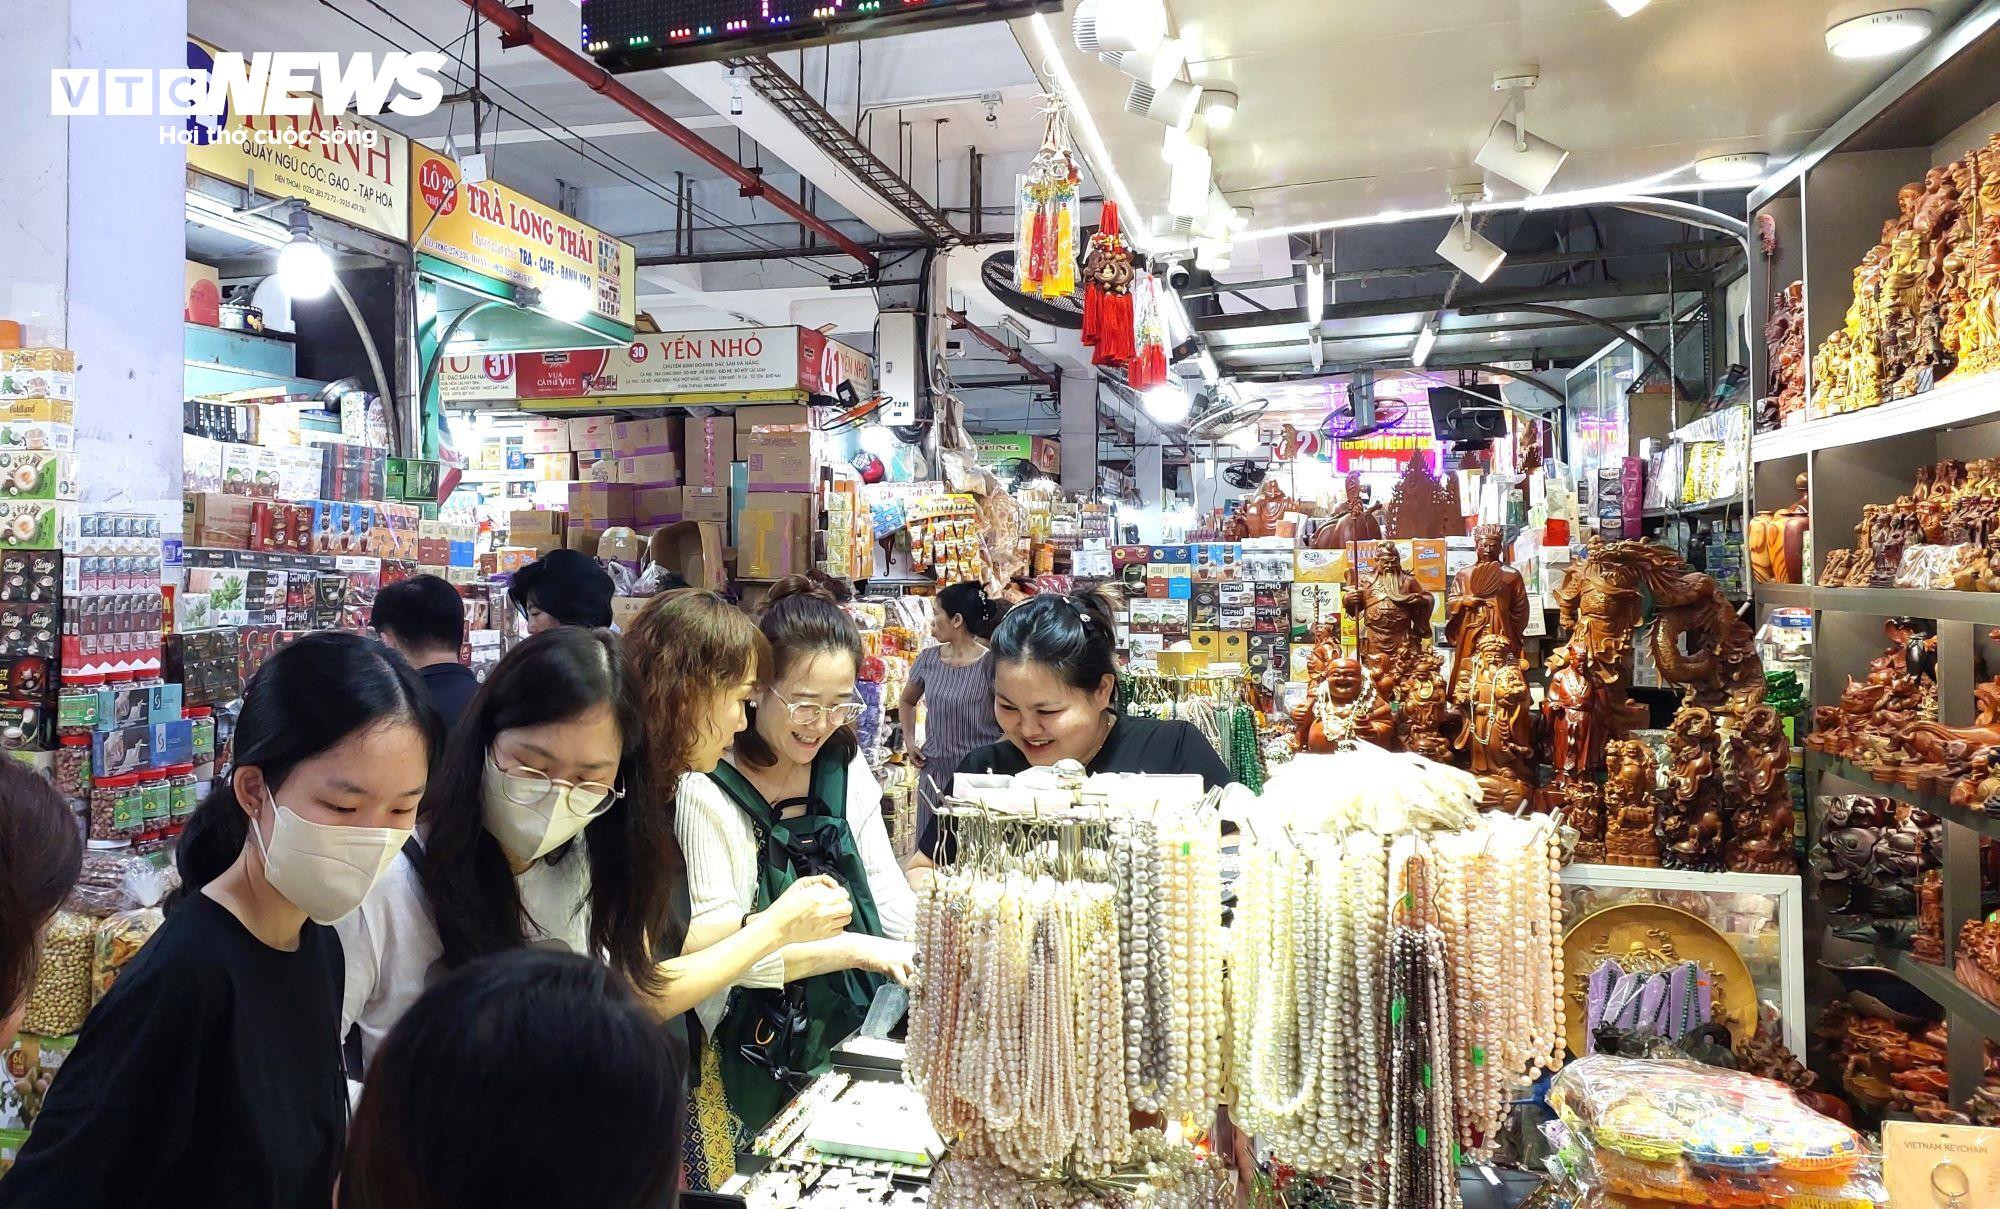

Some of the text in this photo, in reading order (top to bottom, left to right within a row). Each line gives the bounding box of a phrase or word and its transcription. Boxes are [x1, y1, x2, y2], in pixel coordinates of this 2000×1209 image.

[422, 164, 440, 191] LÔ
[359, 183, 374, 201] TẠP
[466, 183, 505, 226] TRÀ
[509, 203, 554, 246] LONG
[632, 332, 763, 360] 30 YẾN NHỎ
[489, 354, 510, 377] 31
[824, 347, 840, 393] 41
[1904, 1141, 1988, 1154] VIETNAM KEYCHAIN
